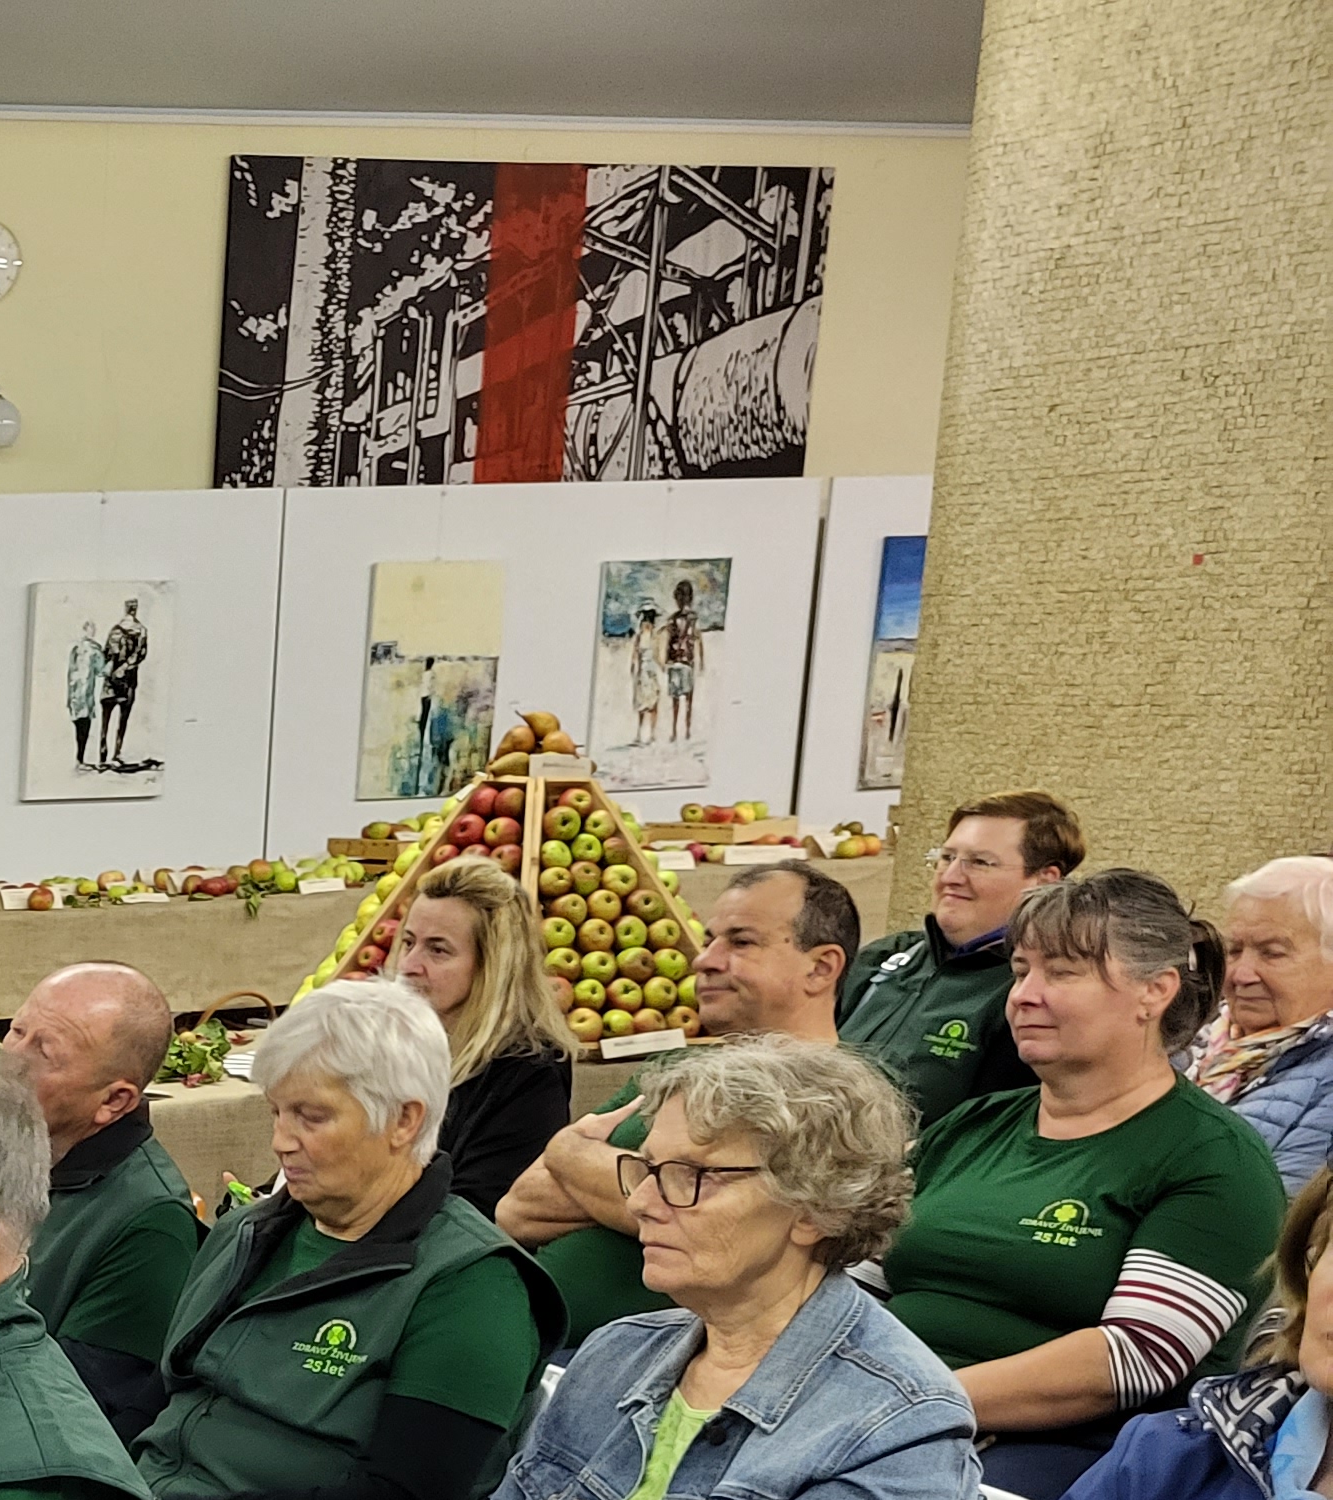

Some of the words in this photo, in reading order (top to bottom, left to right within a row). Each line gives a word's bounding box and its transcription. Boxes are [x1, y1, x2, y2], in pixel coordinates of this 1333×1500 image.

[1032, 1231, 1053, 1243] 25
[1053, 1233, 1077, 1247] let
[302, 1358, 323, 1373] 25
[322, 1359, 345, 1377] let
